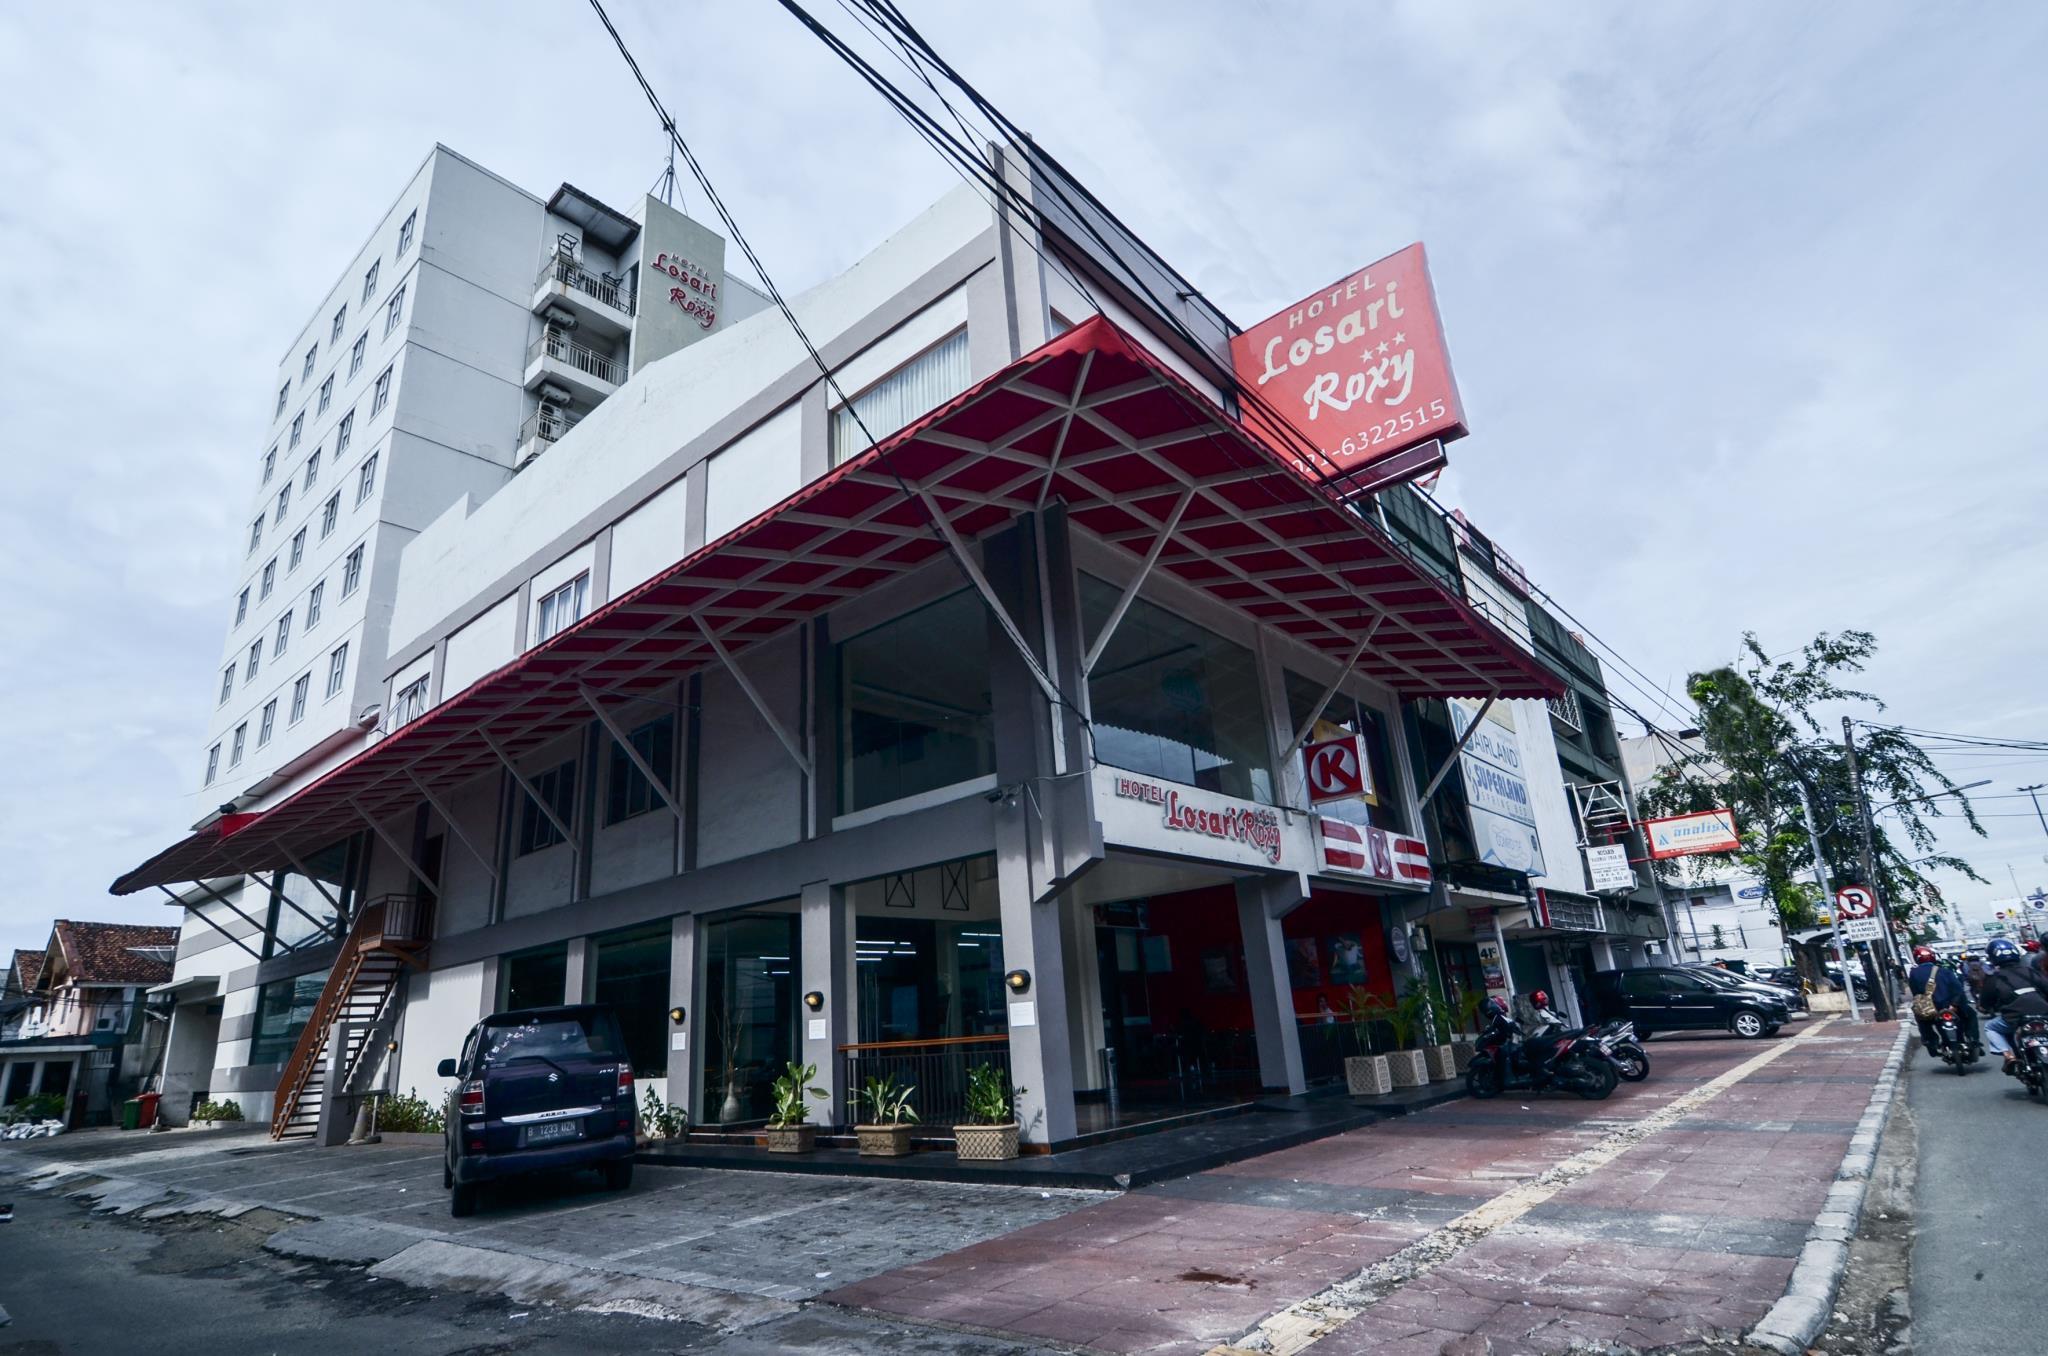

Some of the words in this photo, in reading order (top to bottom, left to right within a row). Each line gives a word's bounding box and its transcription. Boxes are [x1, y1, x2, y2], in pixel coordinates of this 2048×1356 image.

[650, 252, 717, 301] Losari
[1289, 275, 1376, 330] HOTEL
[669, 287, 715, 330] Roxy
[1258, 281, 1404, 385] Losari
[1303, 349, 1414, 420] Roxy
[1474, 731, 1519, 769] AIRLAND
[1474, 764, 1527, 805] SUPERLAND
[1120, 778, 1166, 803] HOTEL
[1168, 790, 1241, 840] Losari
[1242, 810, 1281, 862] Roxy
